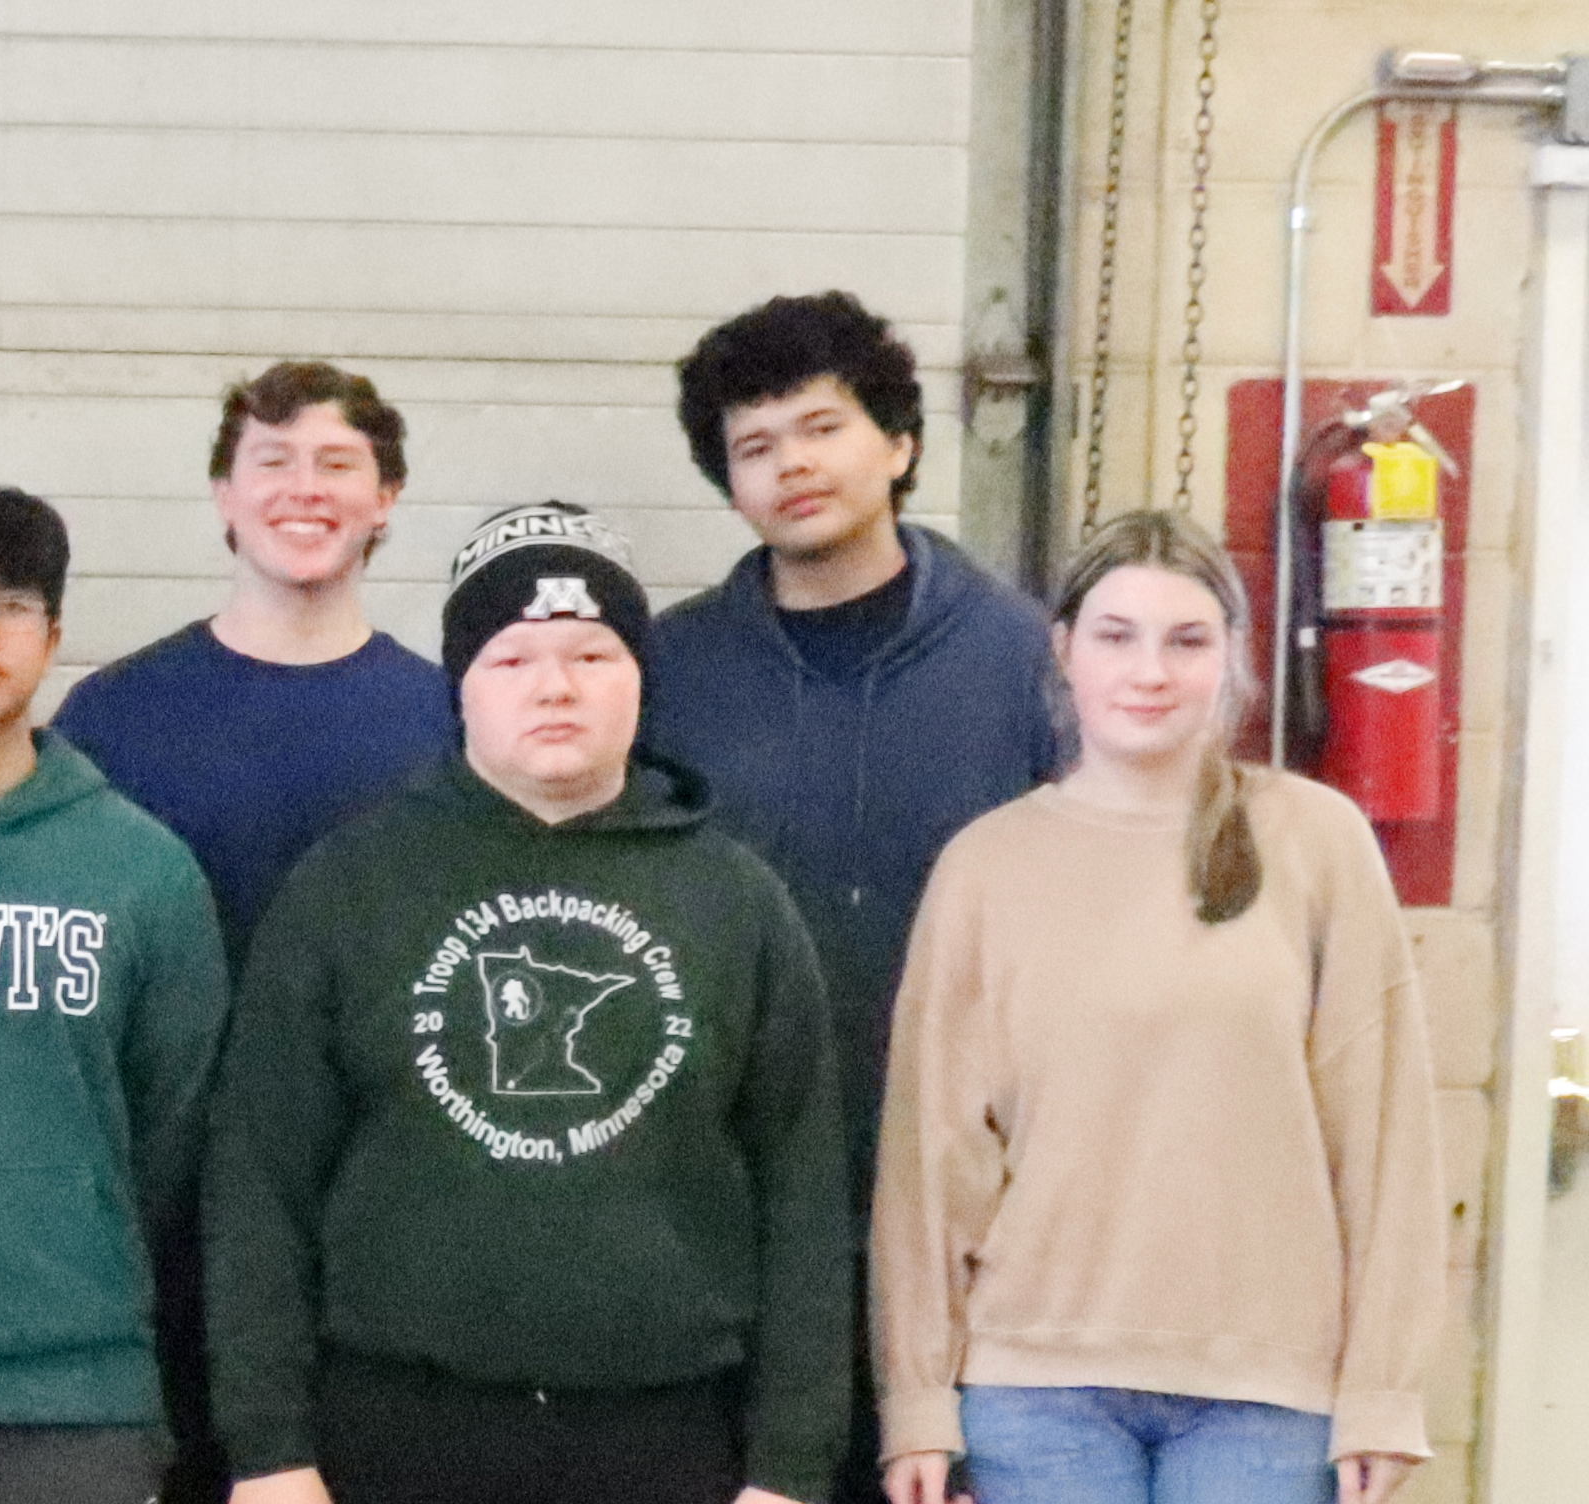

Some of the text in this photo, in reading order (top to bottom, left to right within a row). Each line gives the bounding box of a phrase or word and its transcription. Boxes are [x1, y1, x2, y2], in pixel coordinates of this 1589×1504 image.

[523, 577, 601, 620] M
[413, 889, 684, 1000] Troop 134 Backpacking Crew
[413, 1011, 443, 1033] 20
[666, 1015, 692, 1038] 22
[416, 1043, 686, 1164] Worthington, Minnesota
